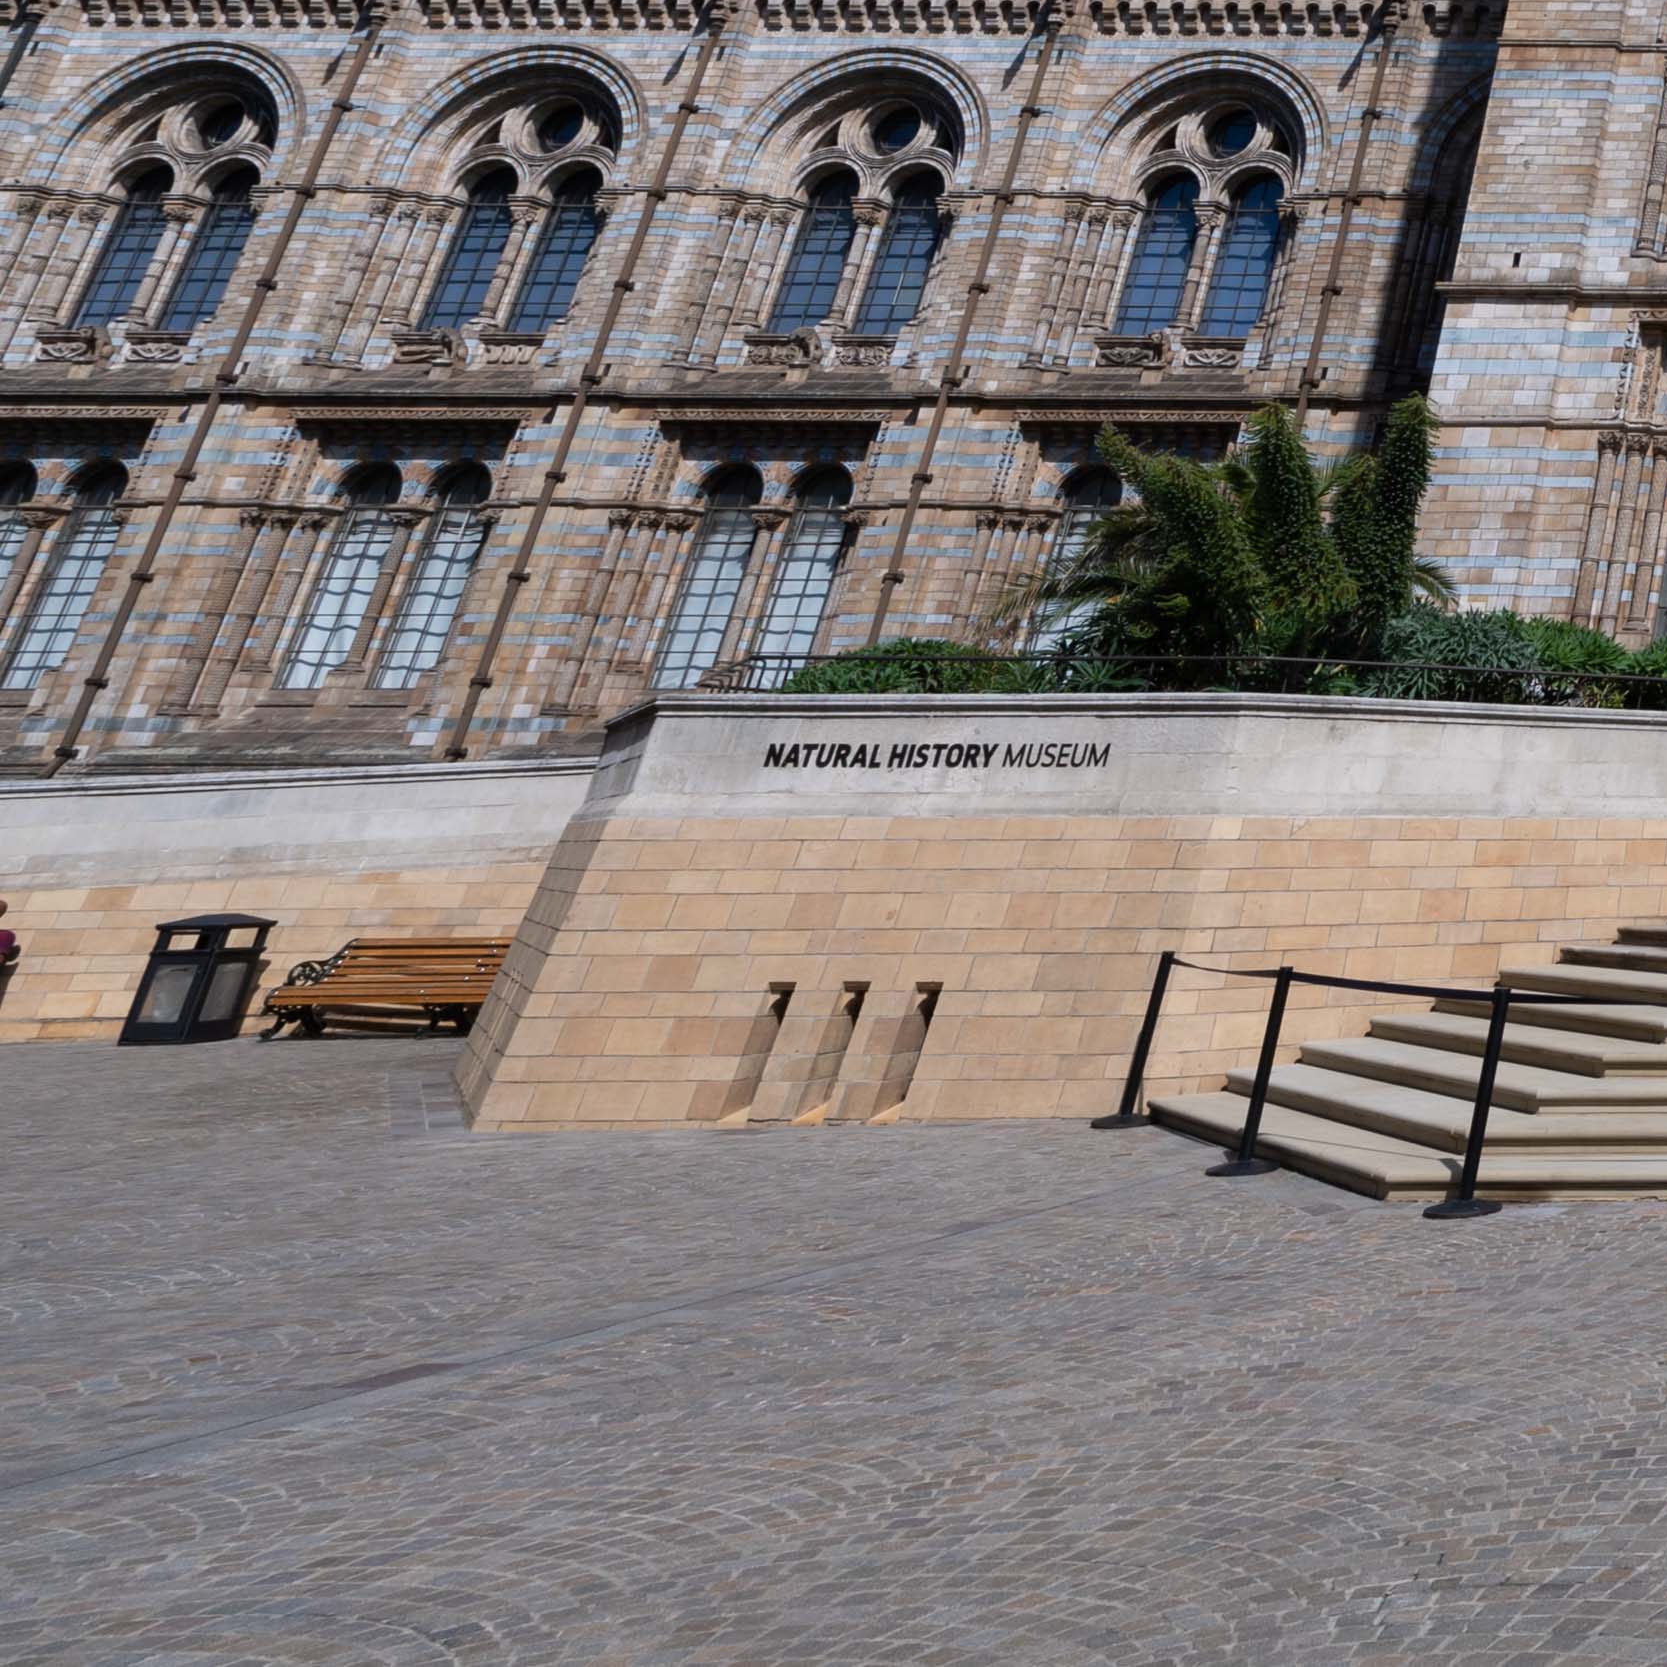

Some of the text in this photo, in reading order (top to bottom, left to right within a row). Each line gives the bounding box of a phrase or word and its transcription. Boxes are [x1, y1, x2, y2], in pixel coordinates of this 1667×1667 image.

[763, 743, 1112, 768] NATURAL HISTORY MUSEUM
